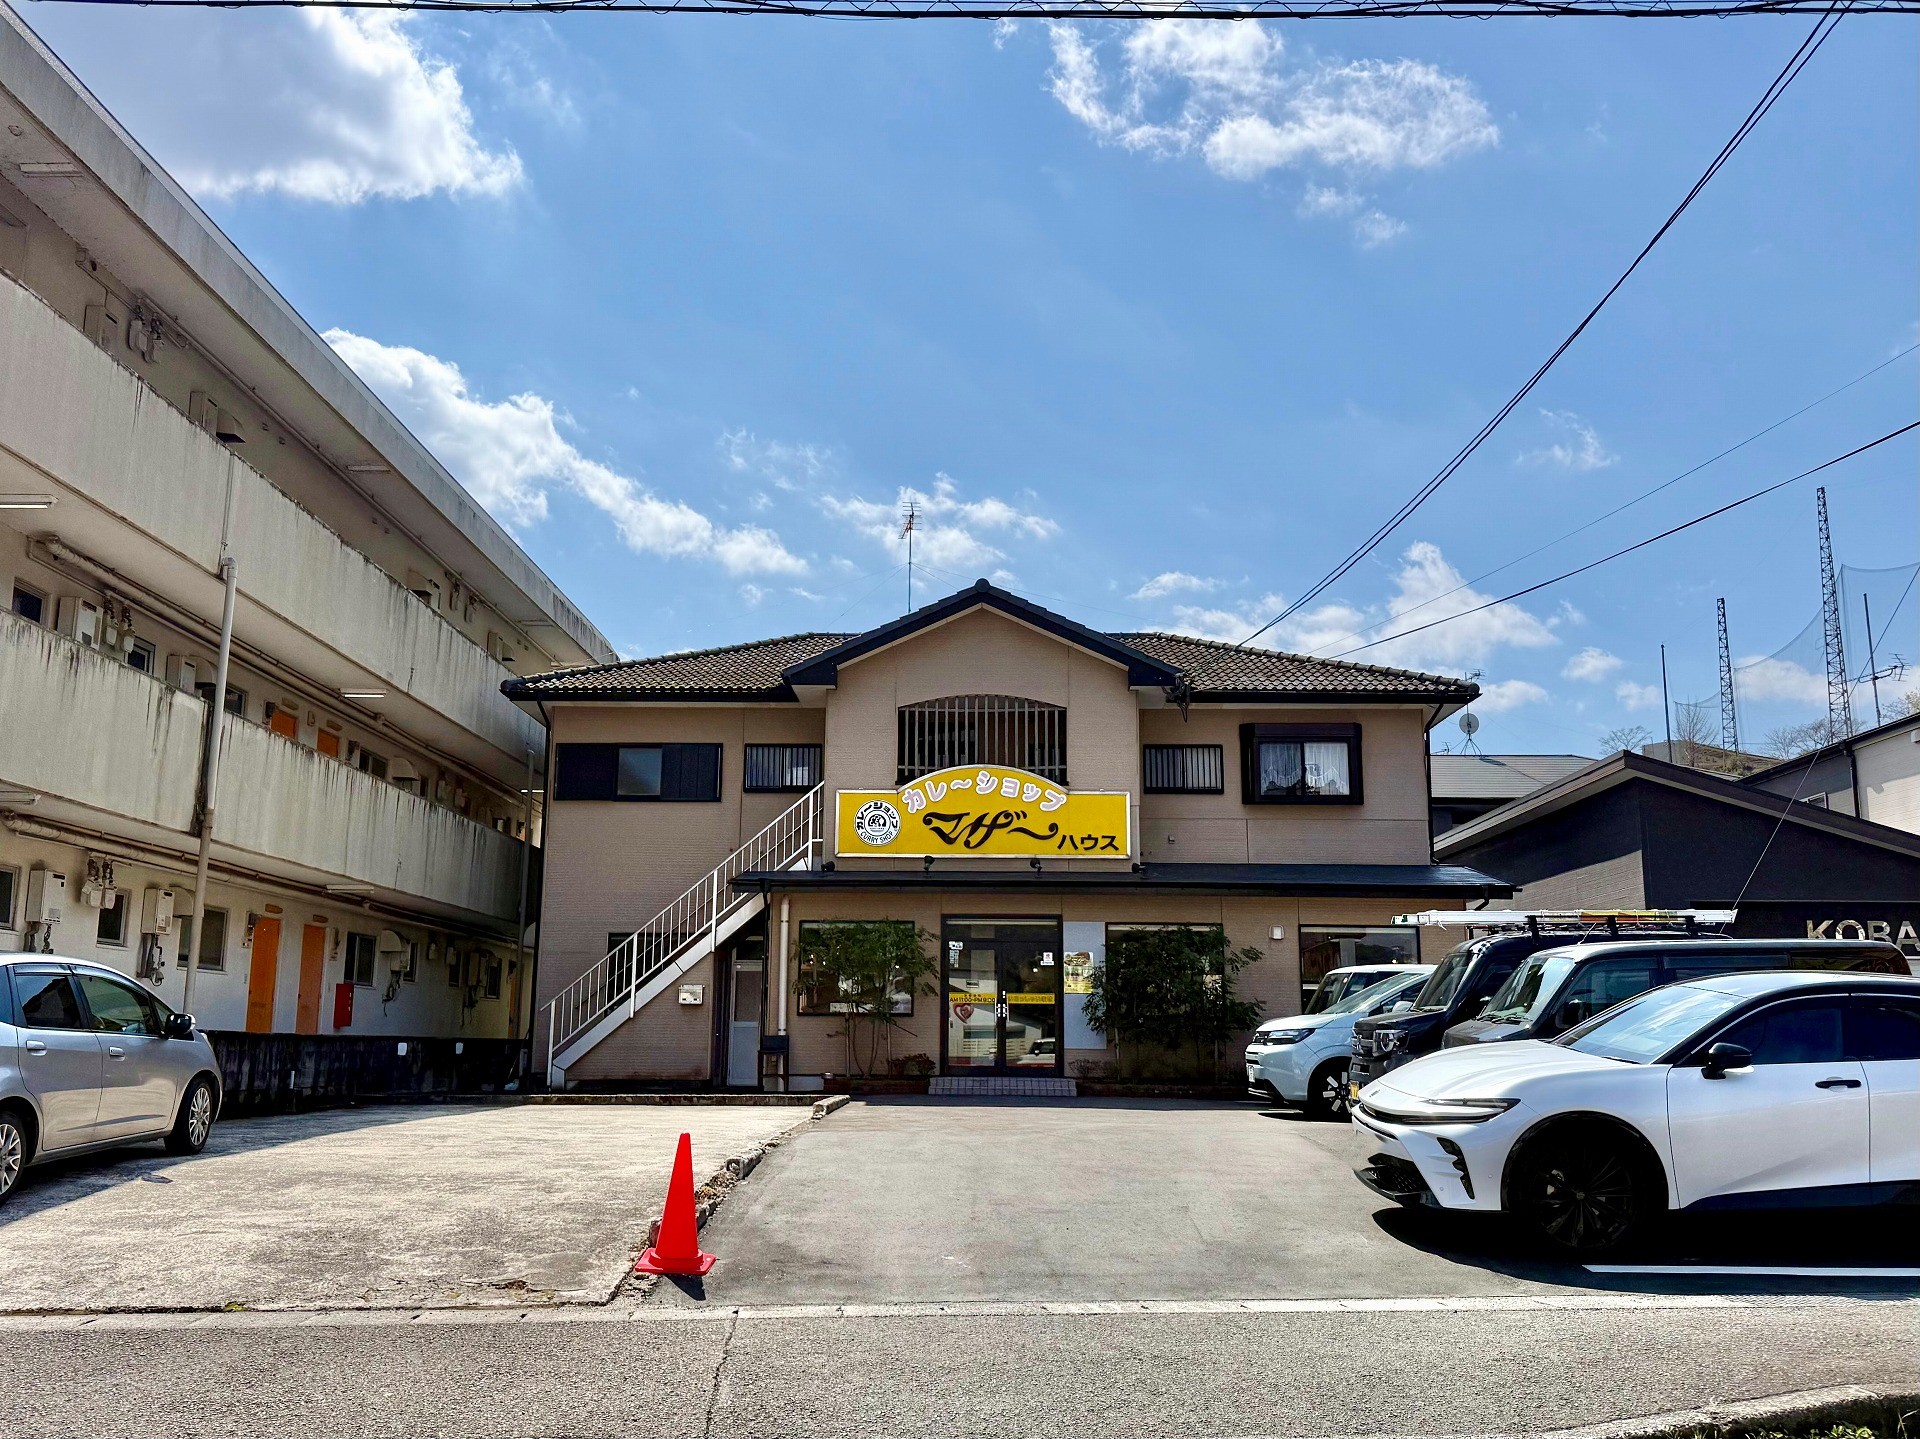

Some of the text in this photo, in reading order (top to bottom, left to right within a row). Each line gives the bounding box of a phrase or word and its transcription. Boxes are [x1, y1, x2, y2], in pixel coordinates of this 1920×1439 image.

[860, 831, 894, 844] CURRY SHOP
[1057, 834, 1120, 851] ハウス
[1806, 919, 1920, 952] KOBA
